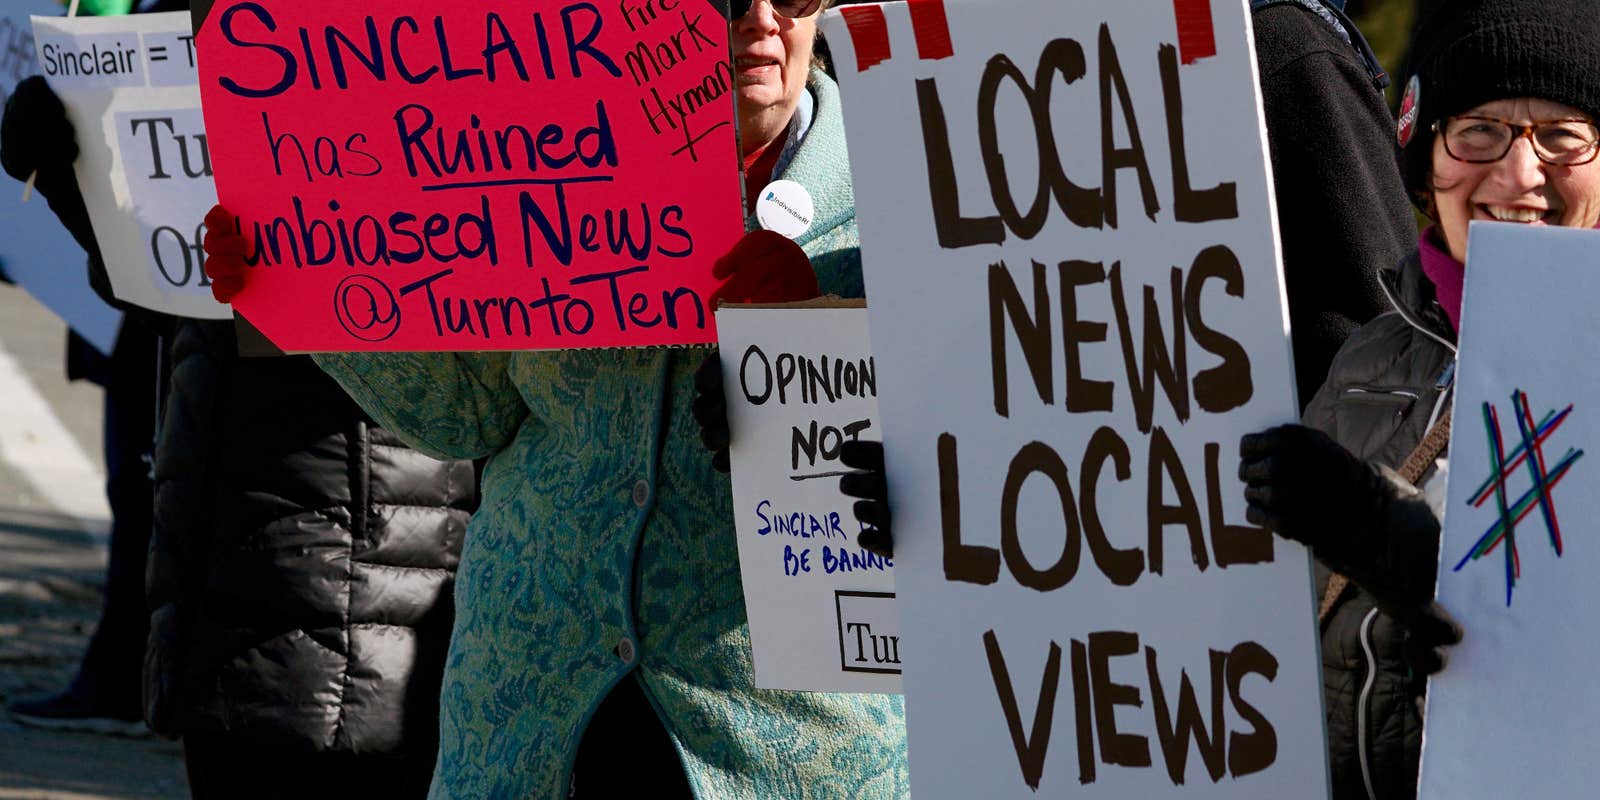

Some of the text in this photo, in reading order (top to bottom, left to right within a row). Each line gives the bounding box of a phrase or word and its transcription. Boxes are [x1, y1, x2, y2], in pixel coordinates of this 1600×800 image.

[42, 42, 136, 76] Sinclair
[218, 1, 622, 98] SINCLAIR
[624, 11, 718, 86] Mark
[262, 100, 618, 183] has Ruined
[640, 61, 733, 163] Hyman
[915, 22, 1240, 249] LOCAL
[235, 184, 694, 268] unbiased News
[334, 266, 706, 342] @TurntoTen
[988, 244, 1254, 434] NEWS
[740, 344, 877, 405] OPINION
[791, 419, 871, 470] NOT
[757, 500, 847, 539] SINCLAIR
[937, 425, 1274, 592] LOCAL
[784, 546, 811, 576] BE
[983, 629, 1279, 792] VIEWS
